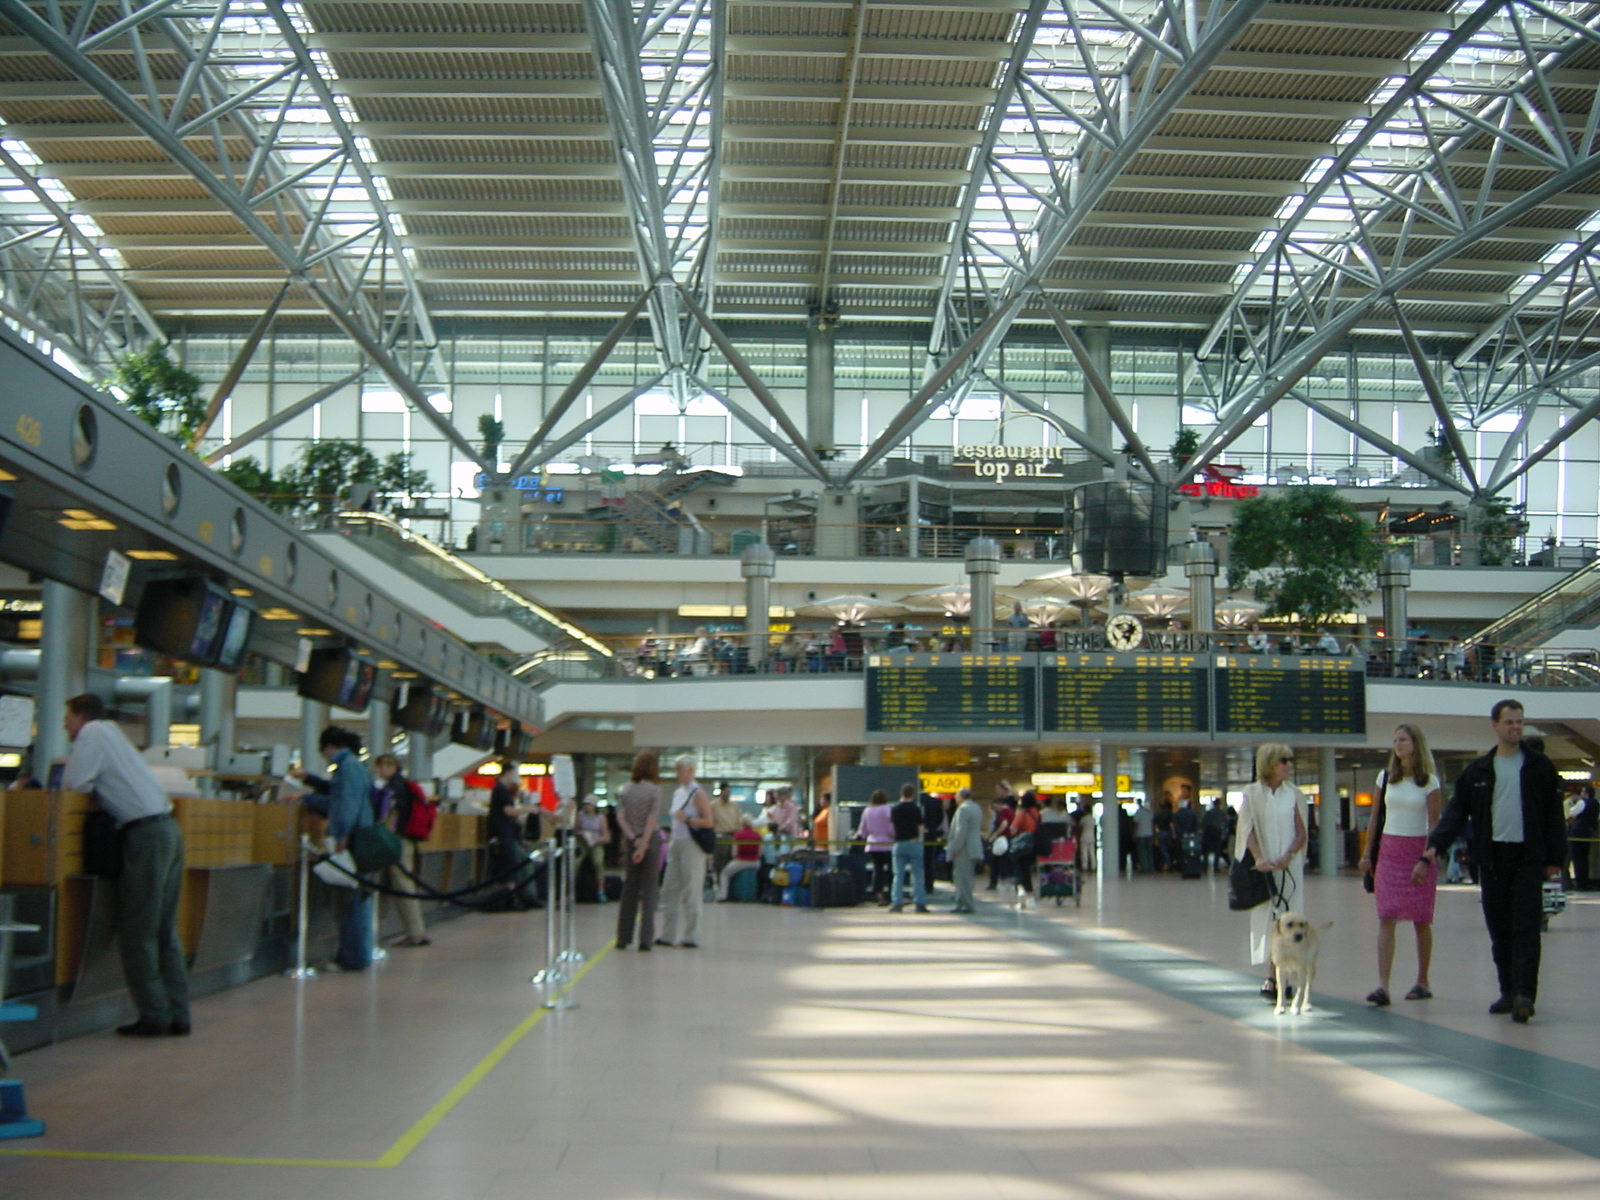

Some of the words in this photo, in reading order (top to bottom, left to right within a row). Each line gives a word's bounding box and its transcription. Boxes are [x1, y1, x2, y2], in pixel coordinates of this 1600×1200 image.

[953, 443, 1062, 459] restaurant
[975, 460, 1010, 484] top
[1014, 459, 1044, 477] air
[1206, 481, 1259, 500] Wings
